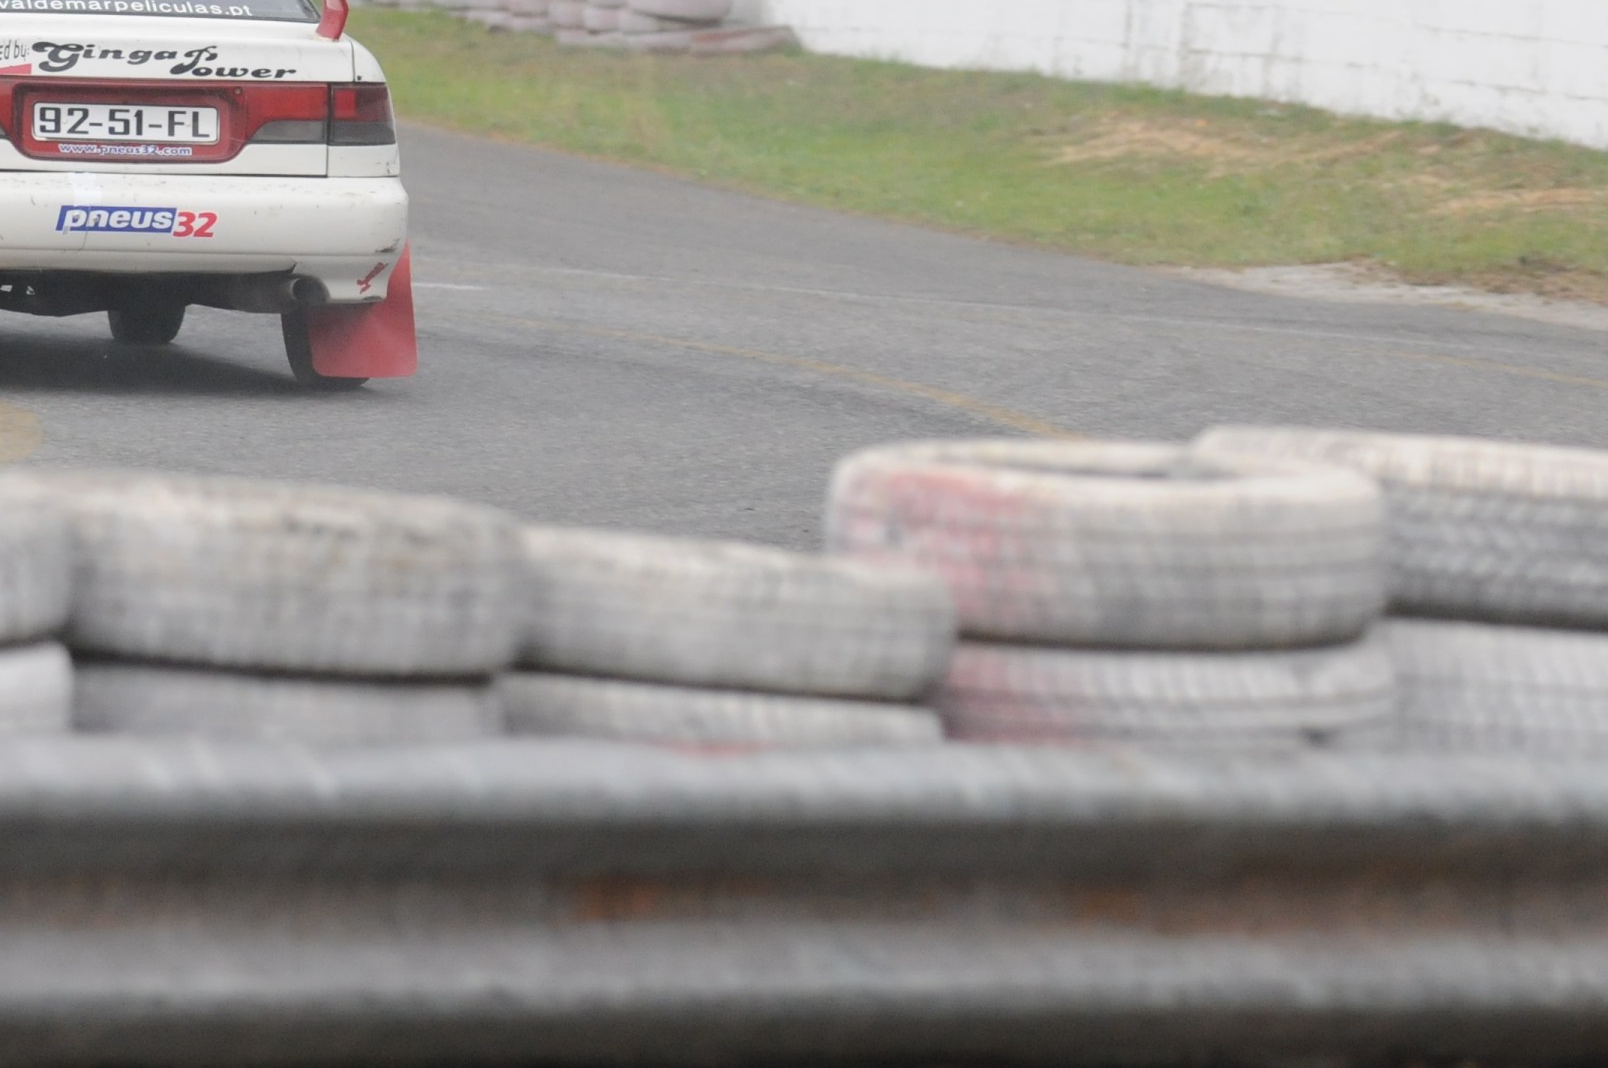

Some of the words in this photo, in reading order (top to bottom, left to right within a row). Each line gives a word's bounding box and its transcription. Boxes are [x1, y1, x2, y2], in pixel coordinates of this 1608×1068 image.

[31, 41, 178, 72] Ginga
[170, 45, 297, 79] Power
[38, 105, 211, 139] 92-51-FL
[59, 143, 192, 157] www.pneus32.com
